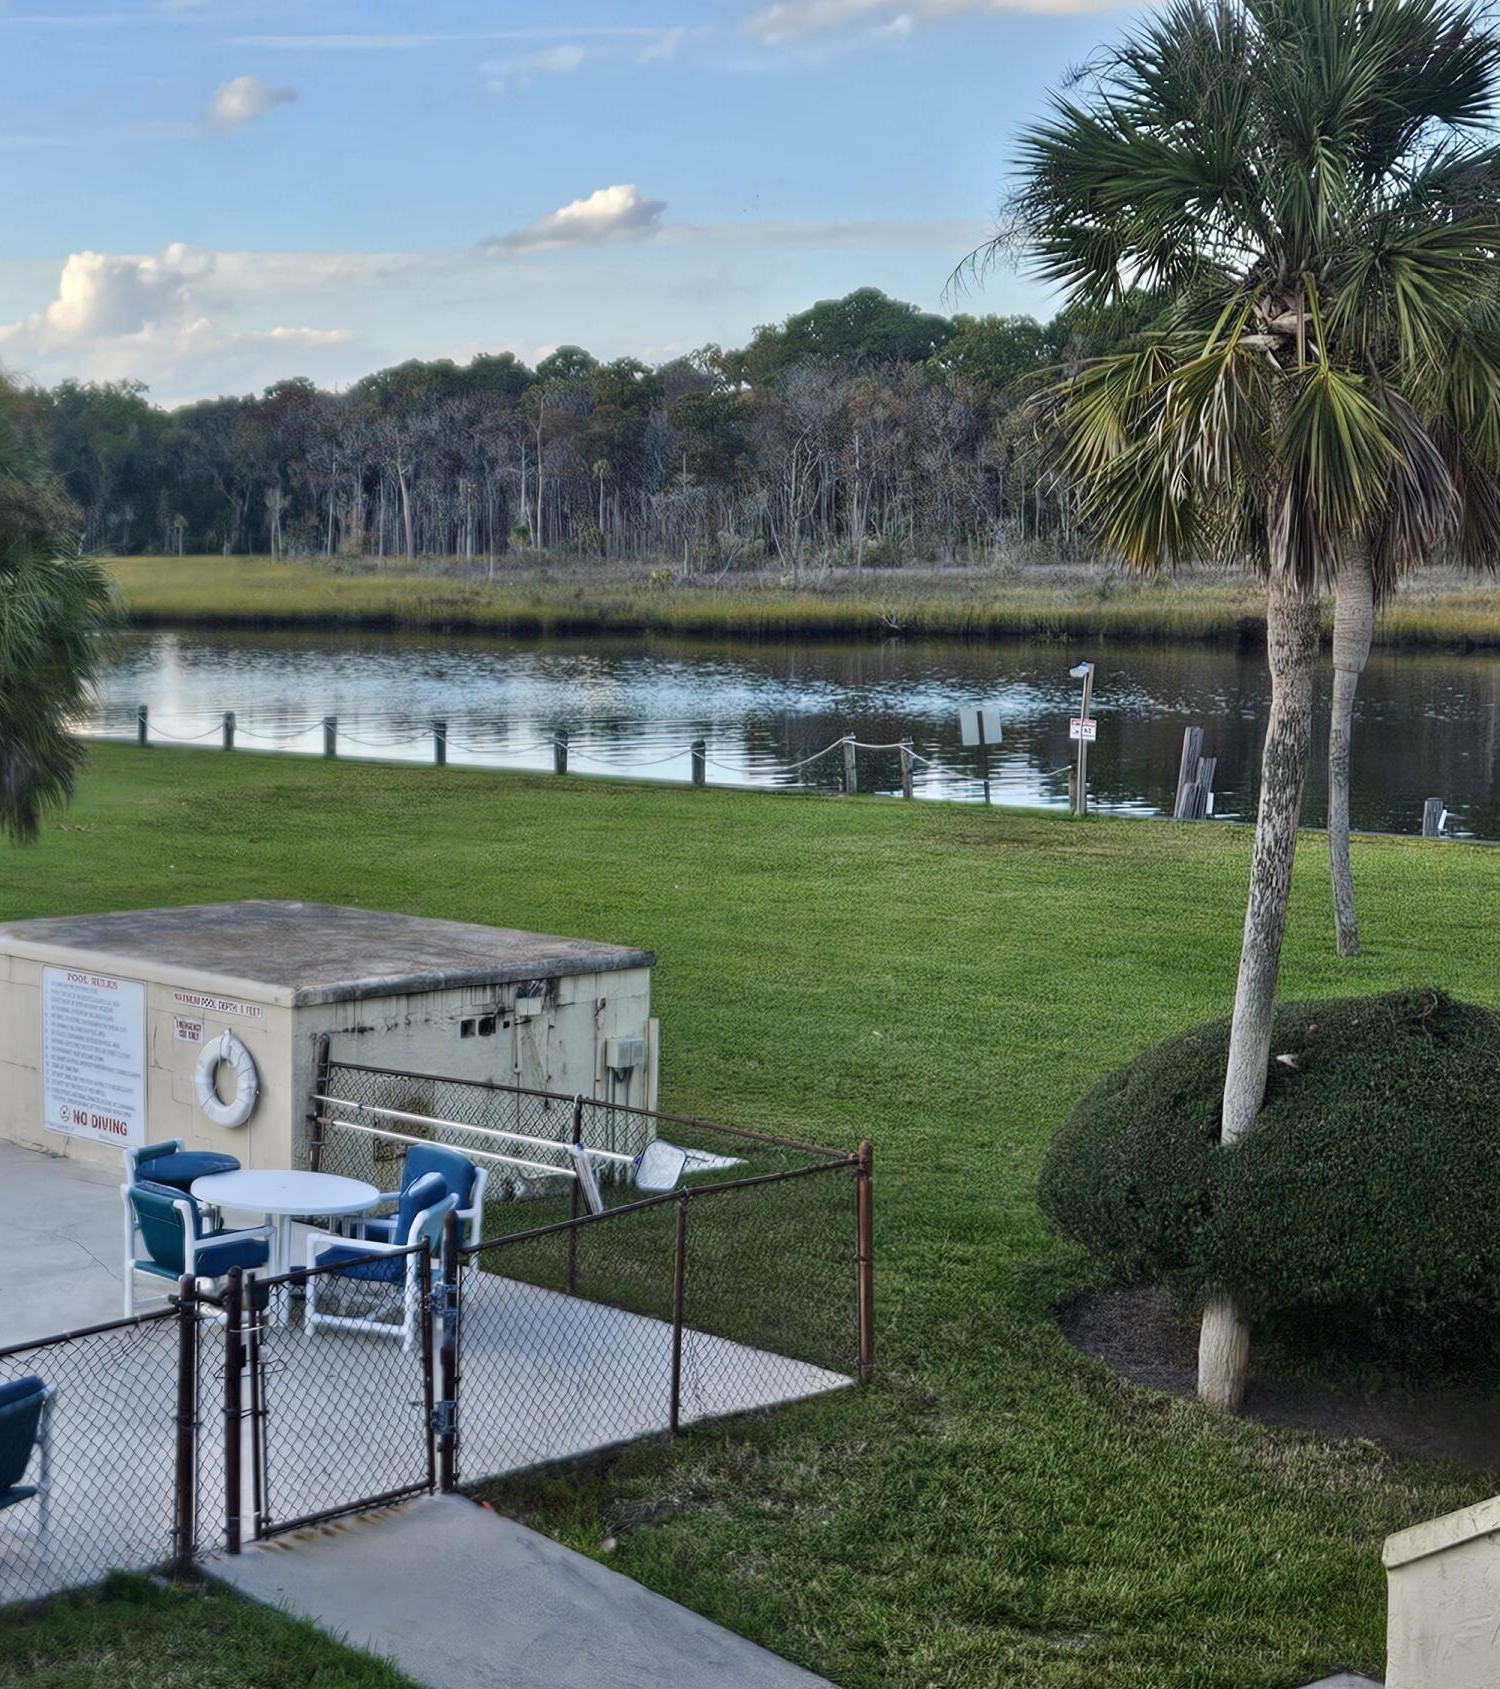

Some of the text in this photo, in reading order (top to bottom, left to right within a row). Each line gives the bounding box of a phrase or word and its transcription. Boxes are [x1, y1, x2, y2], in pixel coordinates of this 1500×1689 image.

[67, 972, 118, 990] POOL RULES
[72, 1109, 88, 1126] NO
[91, 1114, 128, 1136] DIVING
